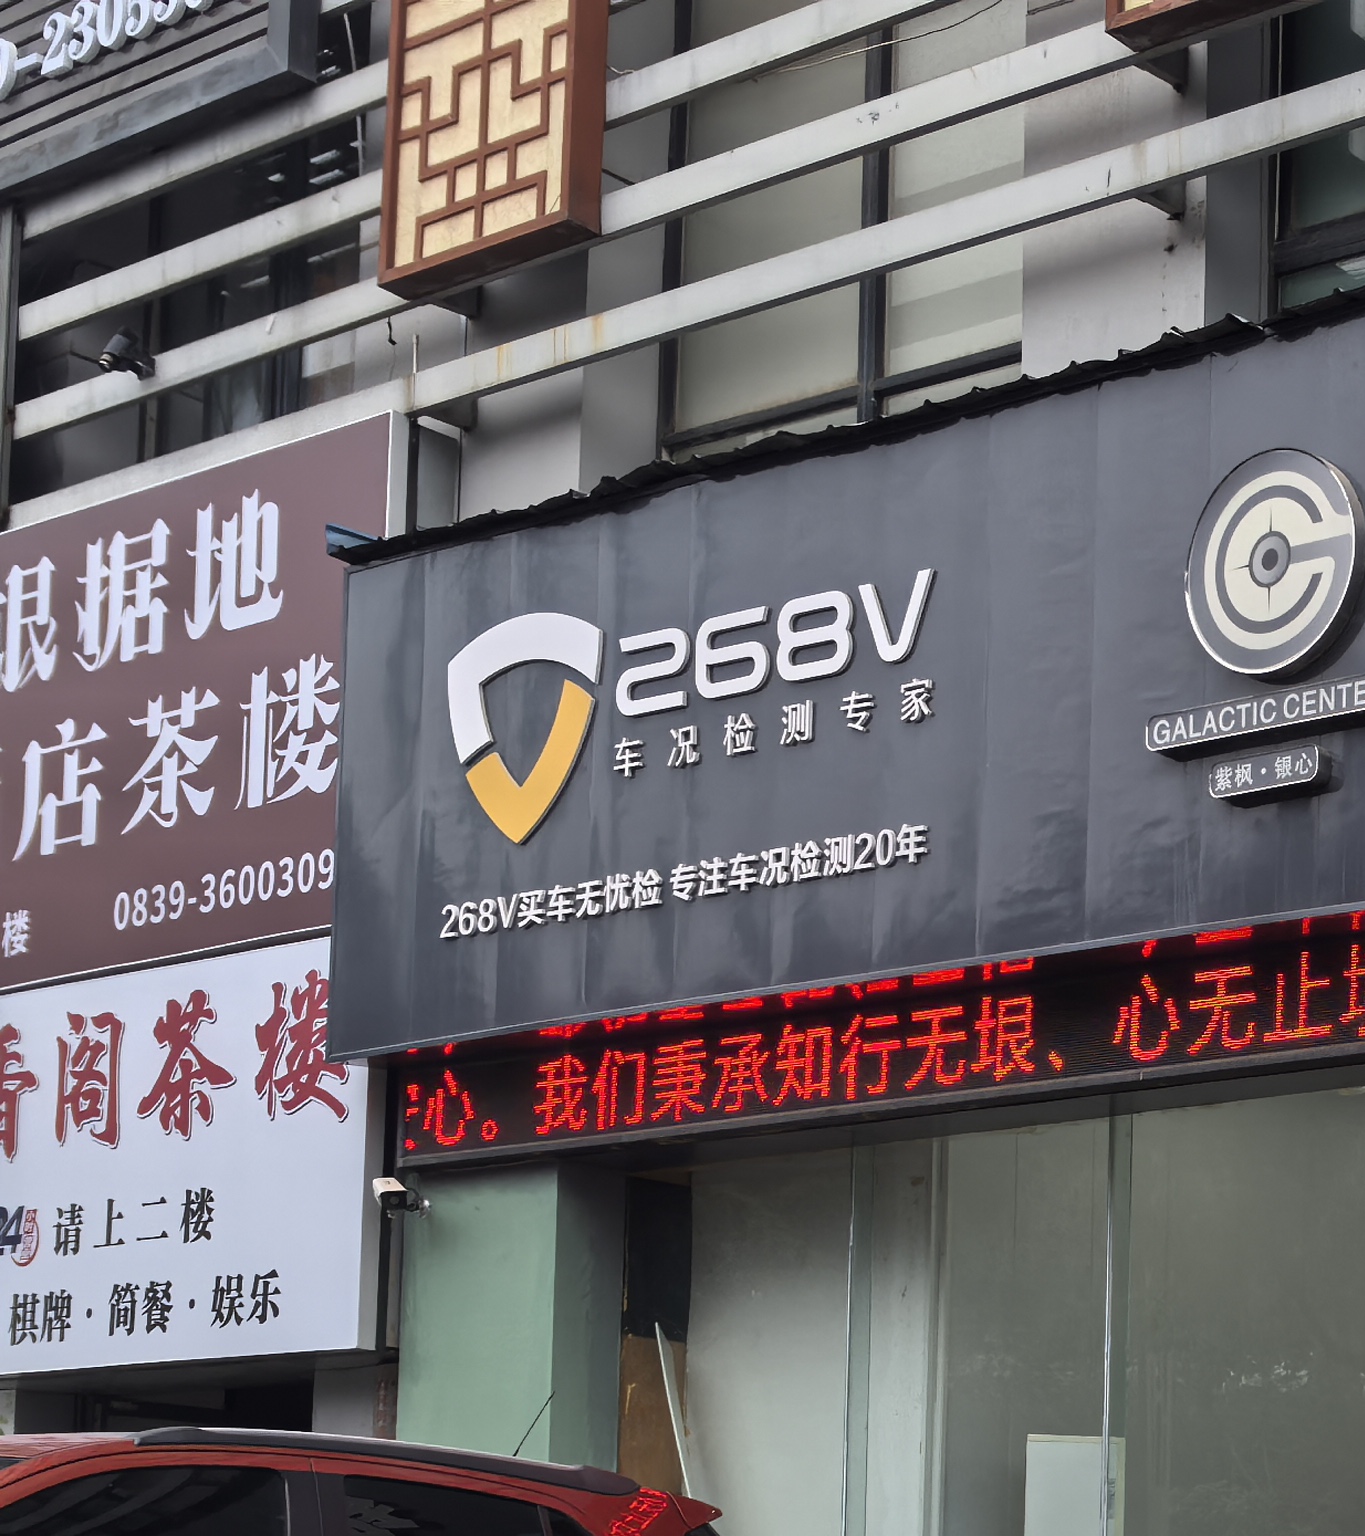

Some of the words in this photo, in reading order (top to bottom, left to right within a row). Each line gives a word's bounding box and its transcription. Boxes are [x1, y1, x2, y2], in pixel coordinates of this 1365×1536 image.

[615, 567, 936, 718] 268V
[613, 677, 934, 777] 车况检测专家
[1152, 698, 1277, 745] GALACTIC
[2, 909, 31, 957] 楼
[113, 848, 335, 930] 0839-3600309
[439, 868, 662, 940] 268V买车无忧检
[669, 822, 929, 901] 专注车况检测20年
[53, 1187, 215, 1256] 请上二楼
